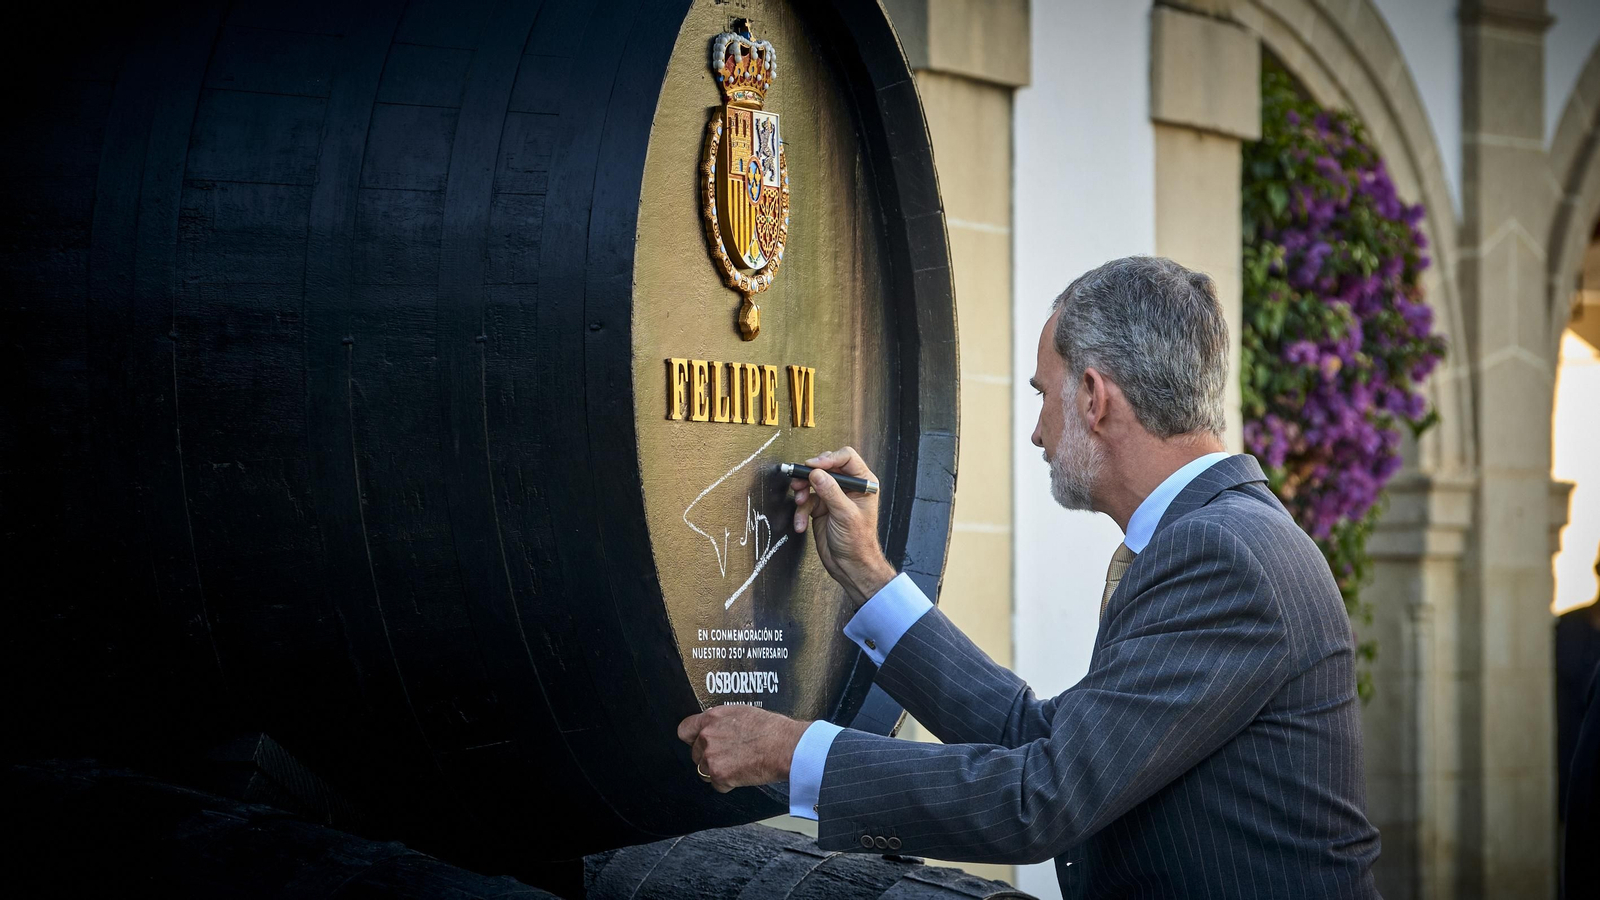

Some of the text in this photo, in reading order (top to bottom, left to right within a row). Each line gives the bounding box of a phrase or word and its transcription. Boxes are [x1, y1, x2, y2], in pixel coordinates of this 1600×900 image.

[666, 358, 816, 428] FELIPE VI
[698, 627, 783, 642] EN CONMEMORACIÓN DE
[692, 647, 727, 659] NUESTRO
[747, 647, 788, 659] ANIVERSARIO
[706, 671, 763, 694] OSBORNE
